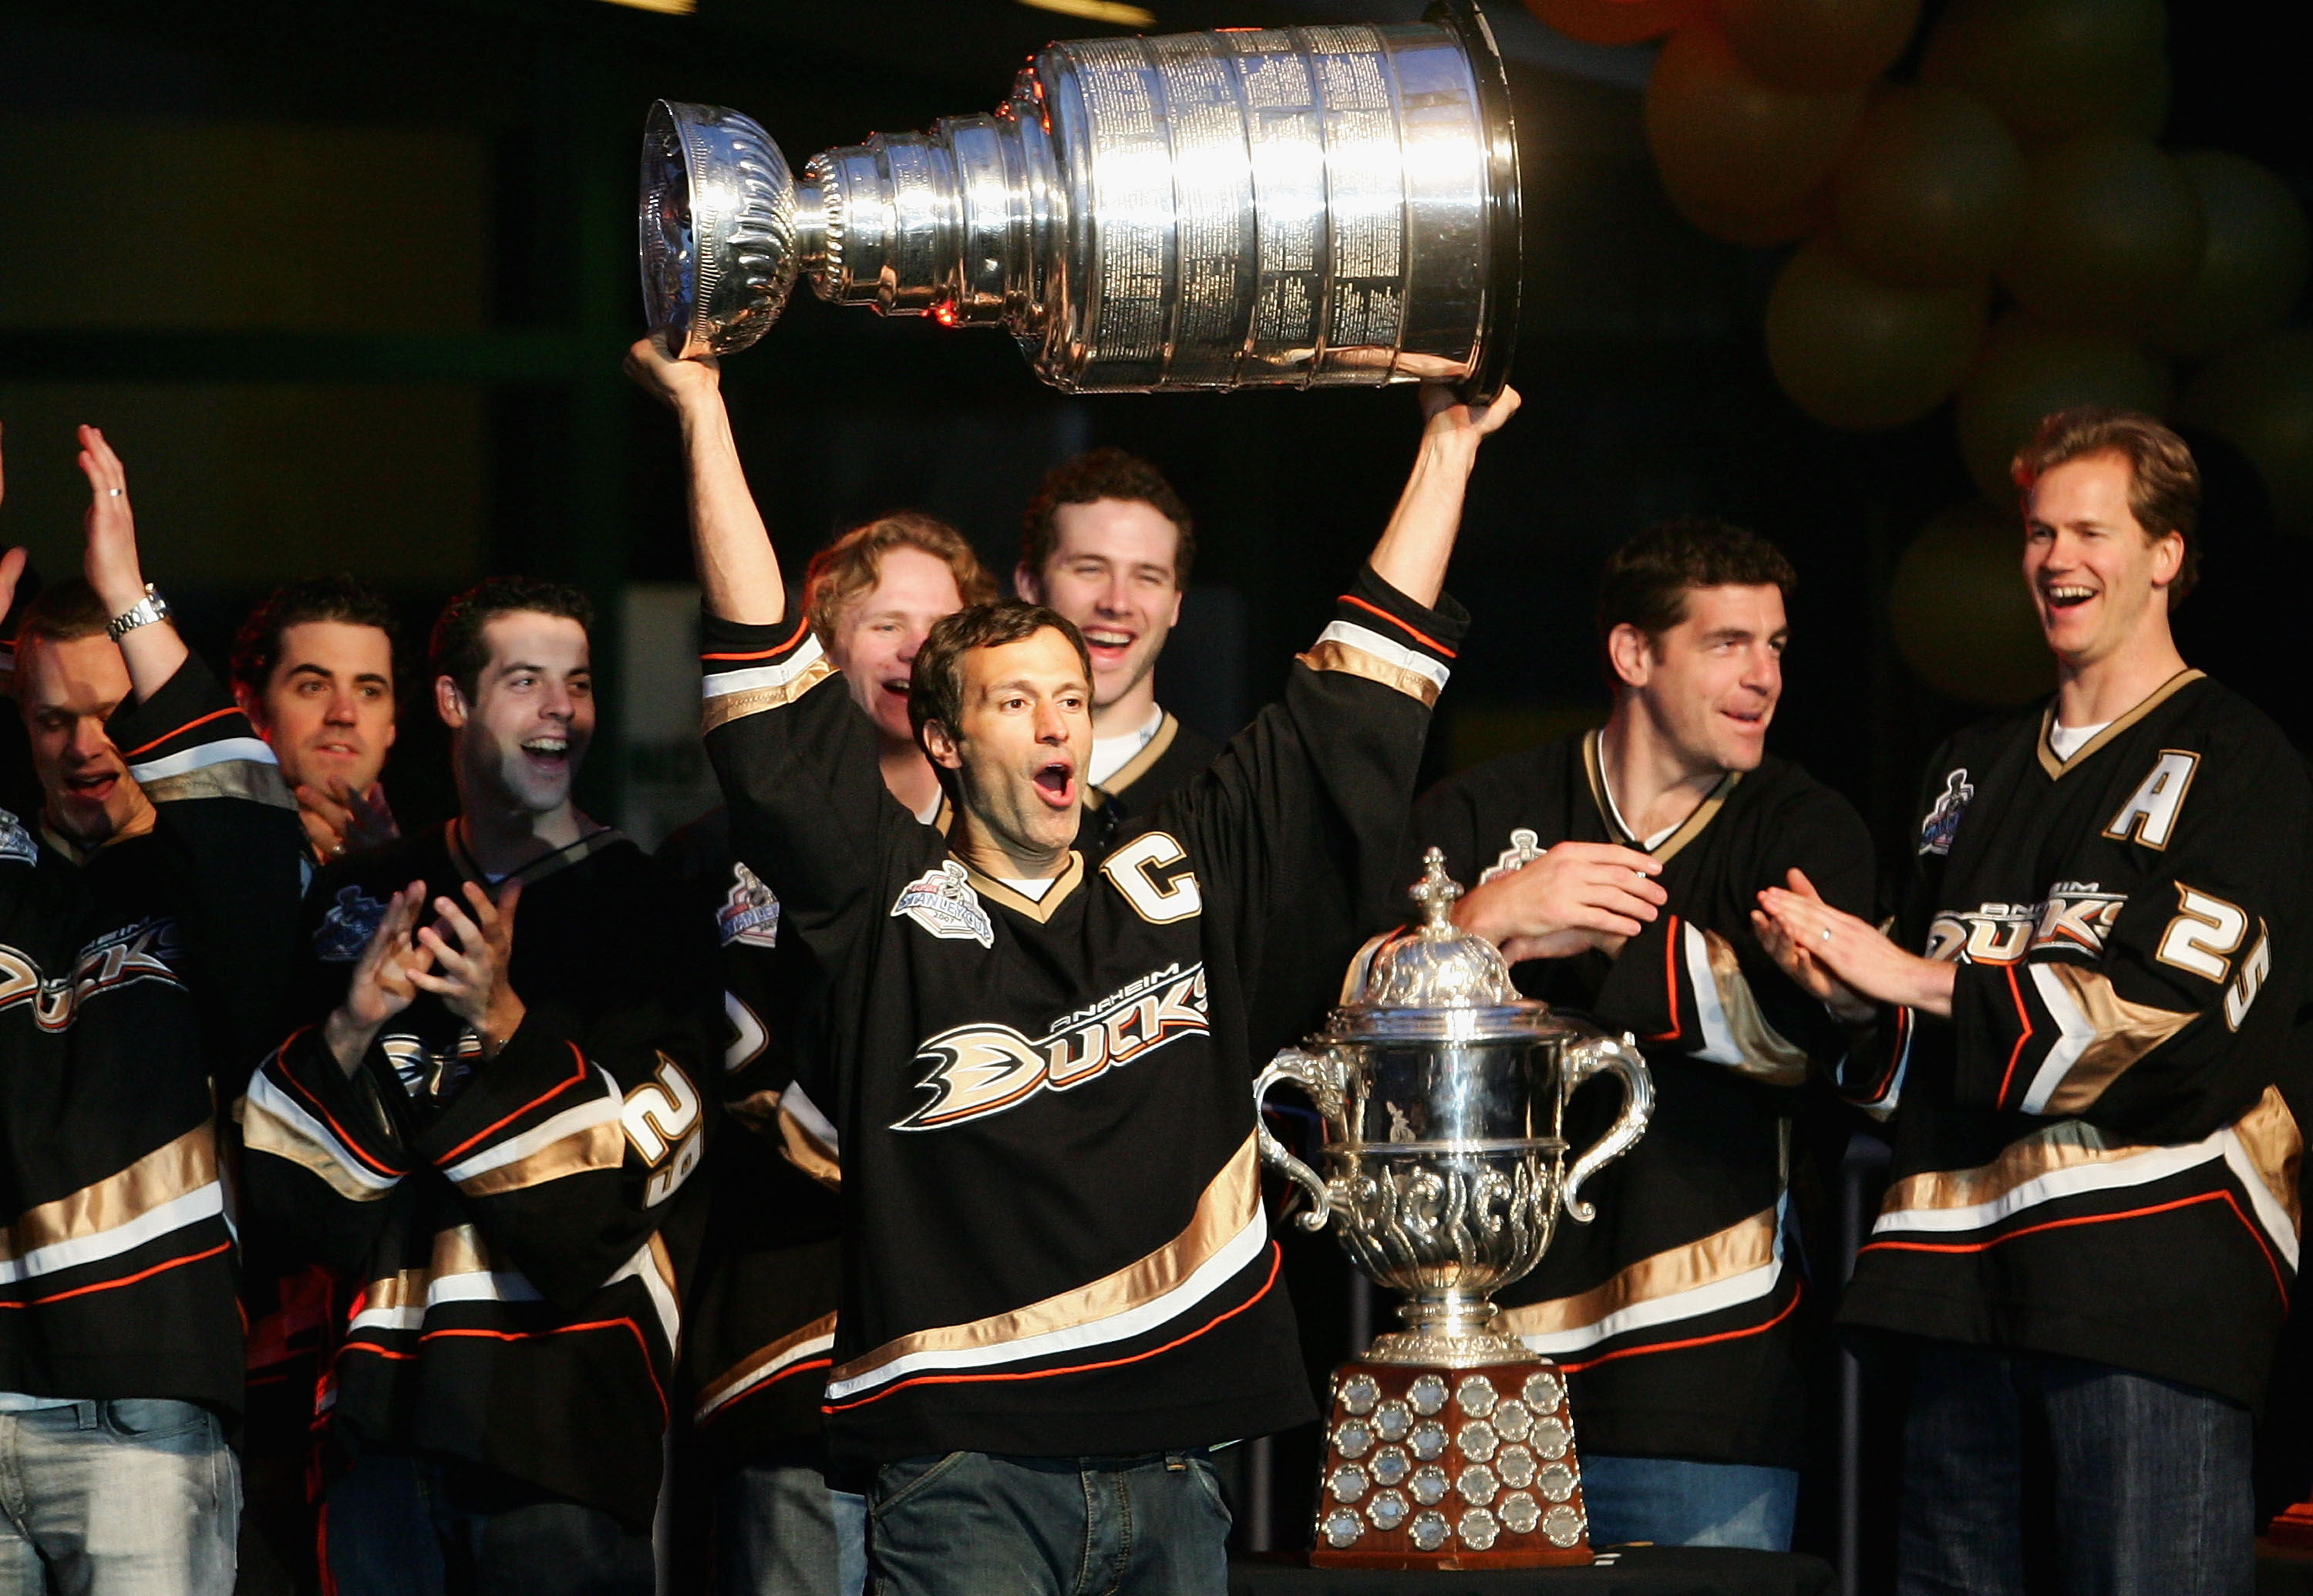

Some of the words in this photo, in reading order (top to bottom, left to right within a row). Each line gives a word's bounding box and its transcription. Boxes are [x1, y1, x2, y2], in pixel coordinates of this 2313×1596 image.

[2100, 749, 2200, 851] A
[896, 891, 965, 918] STANLEY
[963, 911, 992, 941] CUP
[1099, 831, 1203, 925] C
[1049, 961, 1180, 1034] ANAHEIM
[2155, 879, 2272, 1034] 25
